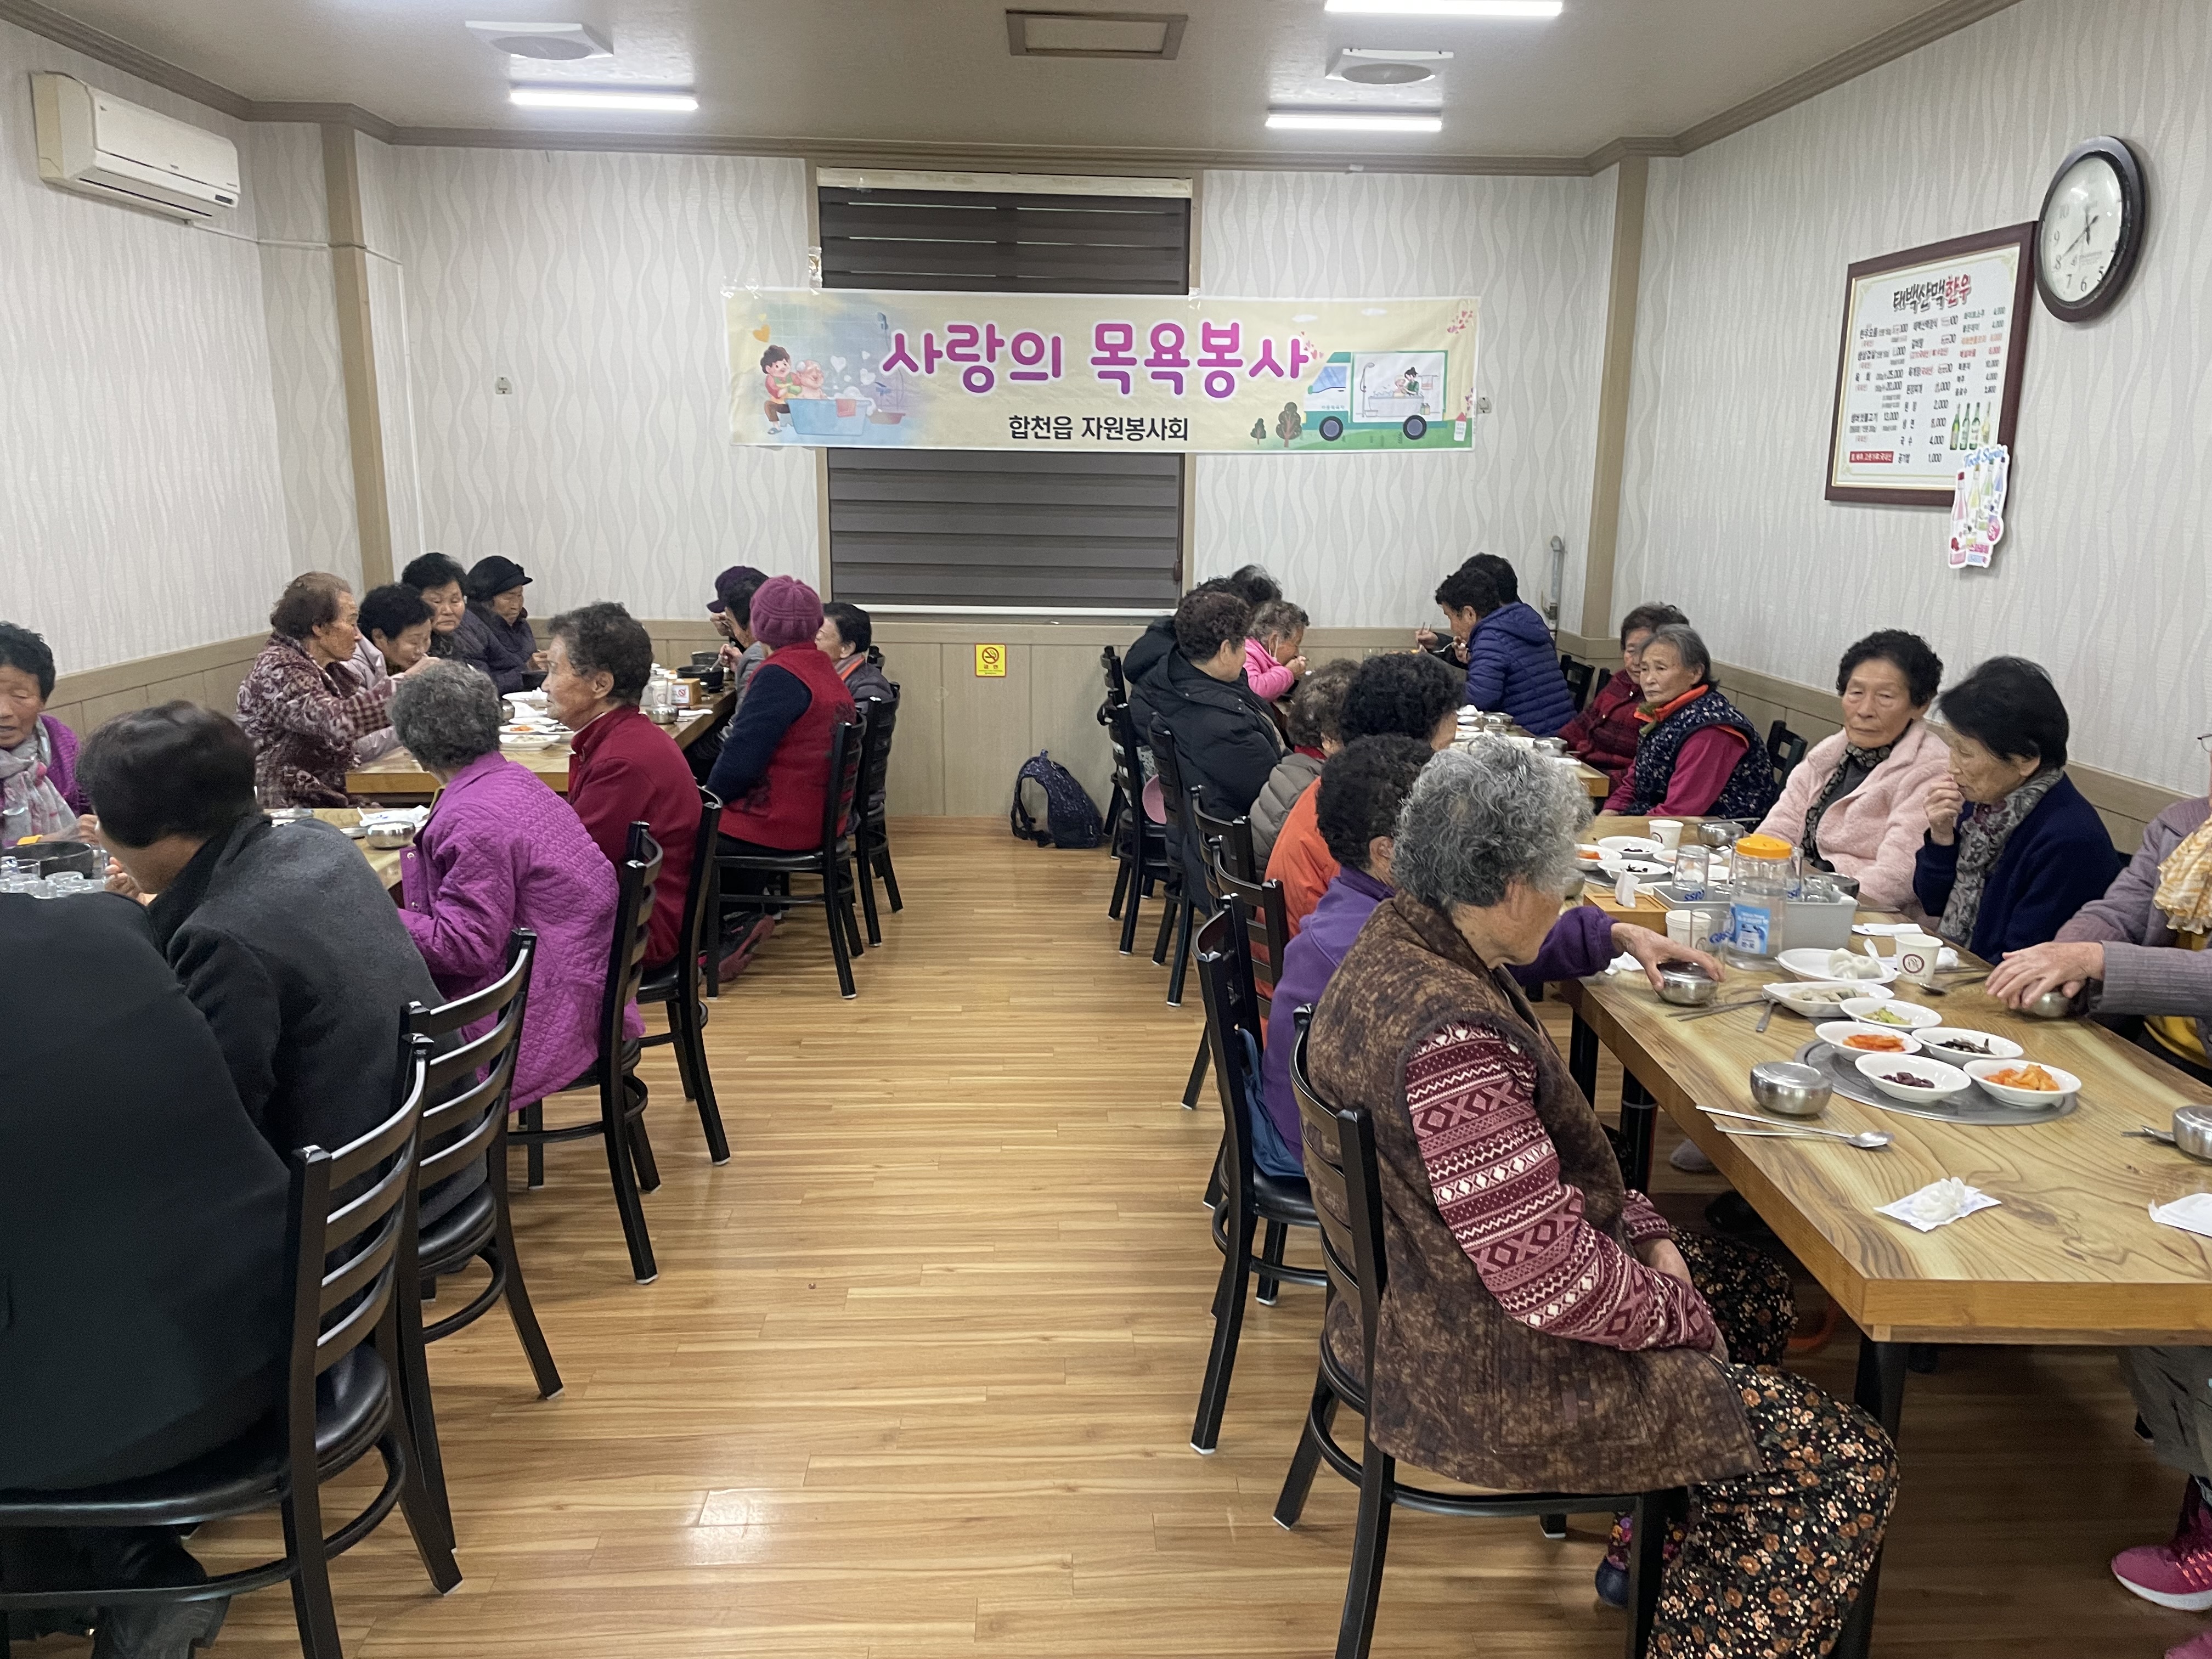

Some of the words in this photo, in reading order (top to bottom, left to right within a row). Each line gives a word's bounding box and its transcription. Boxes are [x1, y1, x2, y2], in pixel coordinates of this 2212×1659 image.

[2080, 276, 2087, 292] 6
[882, 323, 1062, 393] 사랑의
[1091, 321, 1309, 398] 목욕봉사
[1009, 415, 1073, 439] 합천읍
[1081, 416, 1188, 441] 자원봉사회
